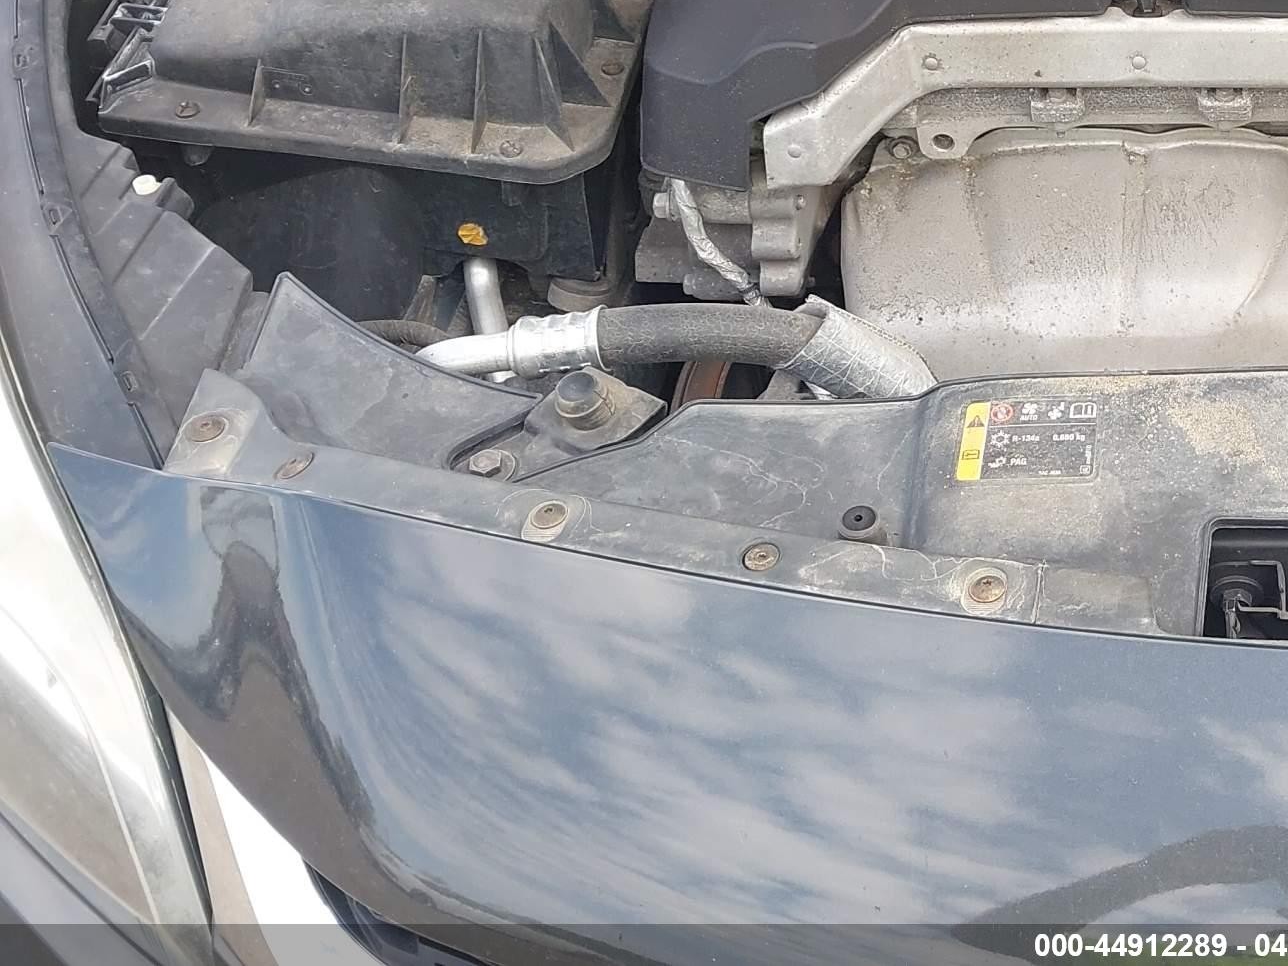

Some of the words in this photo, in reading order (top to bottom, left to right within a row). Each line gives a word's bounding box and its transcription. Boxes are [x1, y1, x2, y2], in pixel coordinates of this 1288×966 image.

[1012, 434, 1040, 442] R-134a
[1076, 431, 1085, 442] kg
[1010, 457, 1027, 466] PAG
